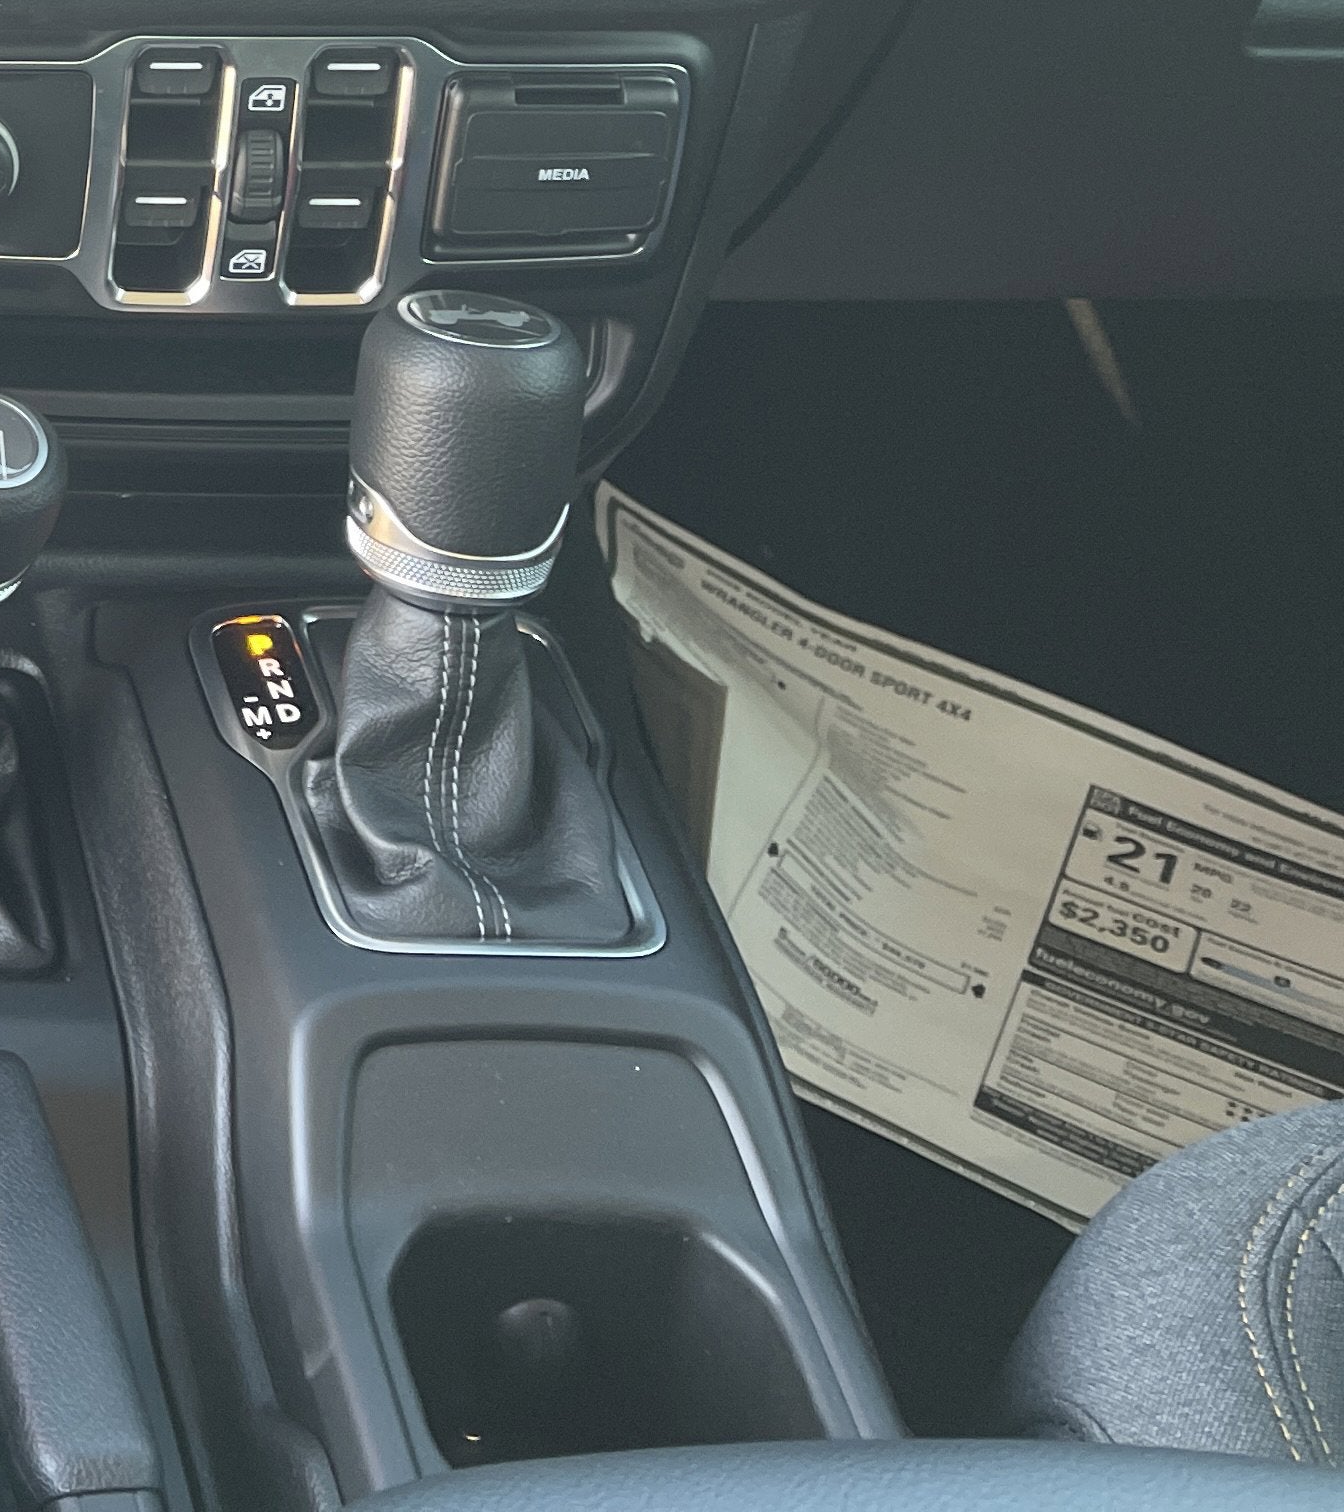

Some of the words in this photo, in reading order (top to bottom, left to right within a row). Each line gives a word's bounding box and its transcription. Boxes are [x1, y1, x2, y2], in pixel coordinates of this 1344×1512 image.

[538, 168, 590, 181] MEDIA
[700, 578, 794, 642] WRANGLER
[798, 637, 866, 678] 4-DOOR
[869, 670, 935, 706] SPORT
[936, 695, 973, 722] 4X4
[257, 658, 285, 677] R
[266, 679, 295, 699] N
[241, 706, 273, 726] M
[275, 703, 301, 723] D
[1105, 835, 1179, 885] 21
[1059, 900, 1170, 954] $2,350
[1034, 947, 1210, 1025] fueleconomy.gov
